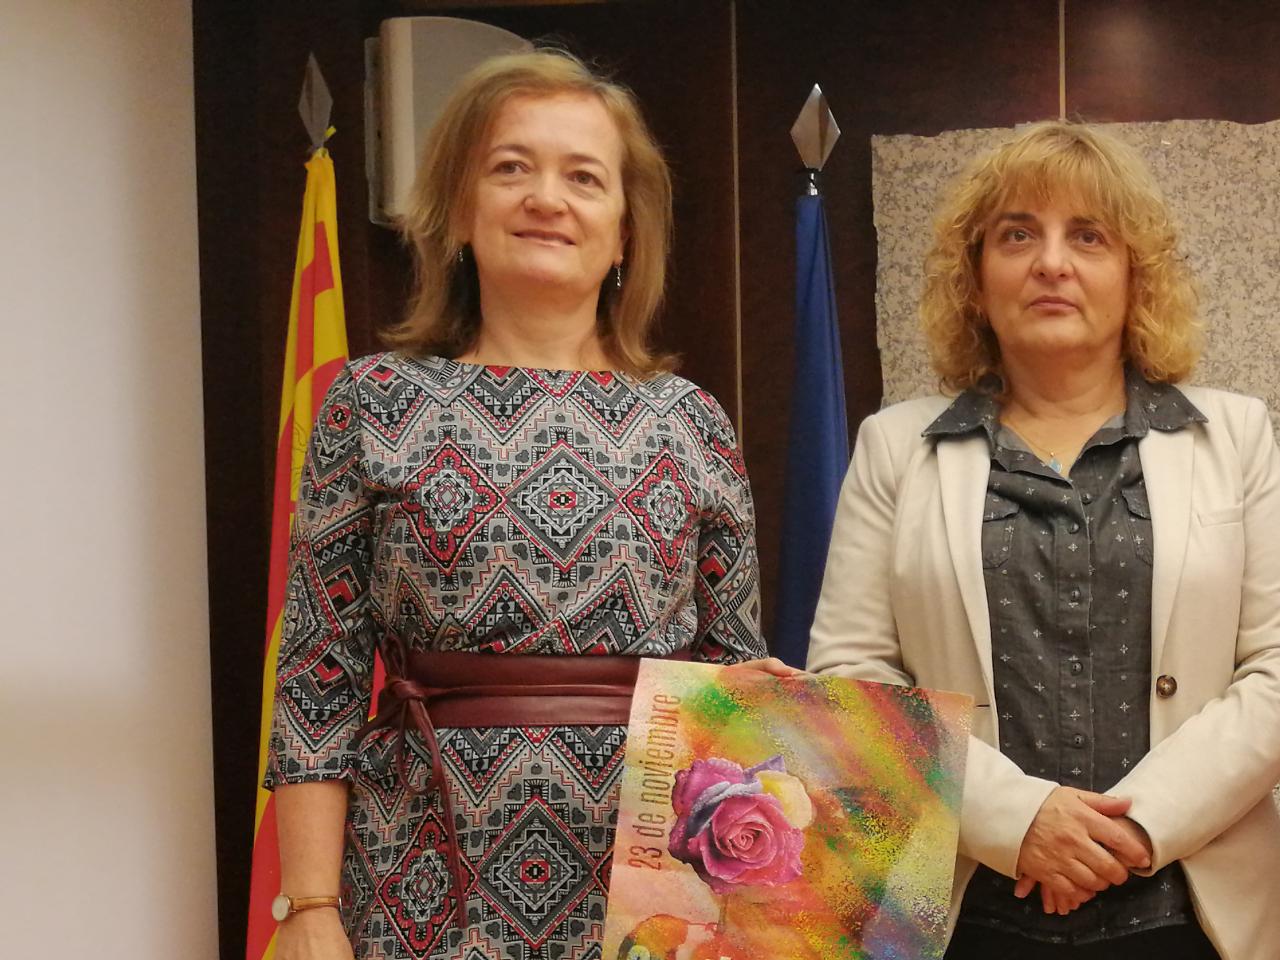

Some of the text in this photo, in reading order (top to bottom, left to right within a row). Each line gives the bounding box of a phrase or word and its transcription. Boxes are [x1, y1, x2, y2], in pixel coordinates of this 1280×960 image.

[628, 694, 681, 871] 23 de noviembre
